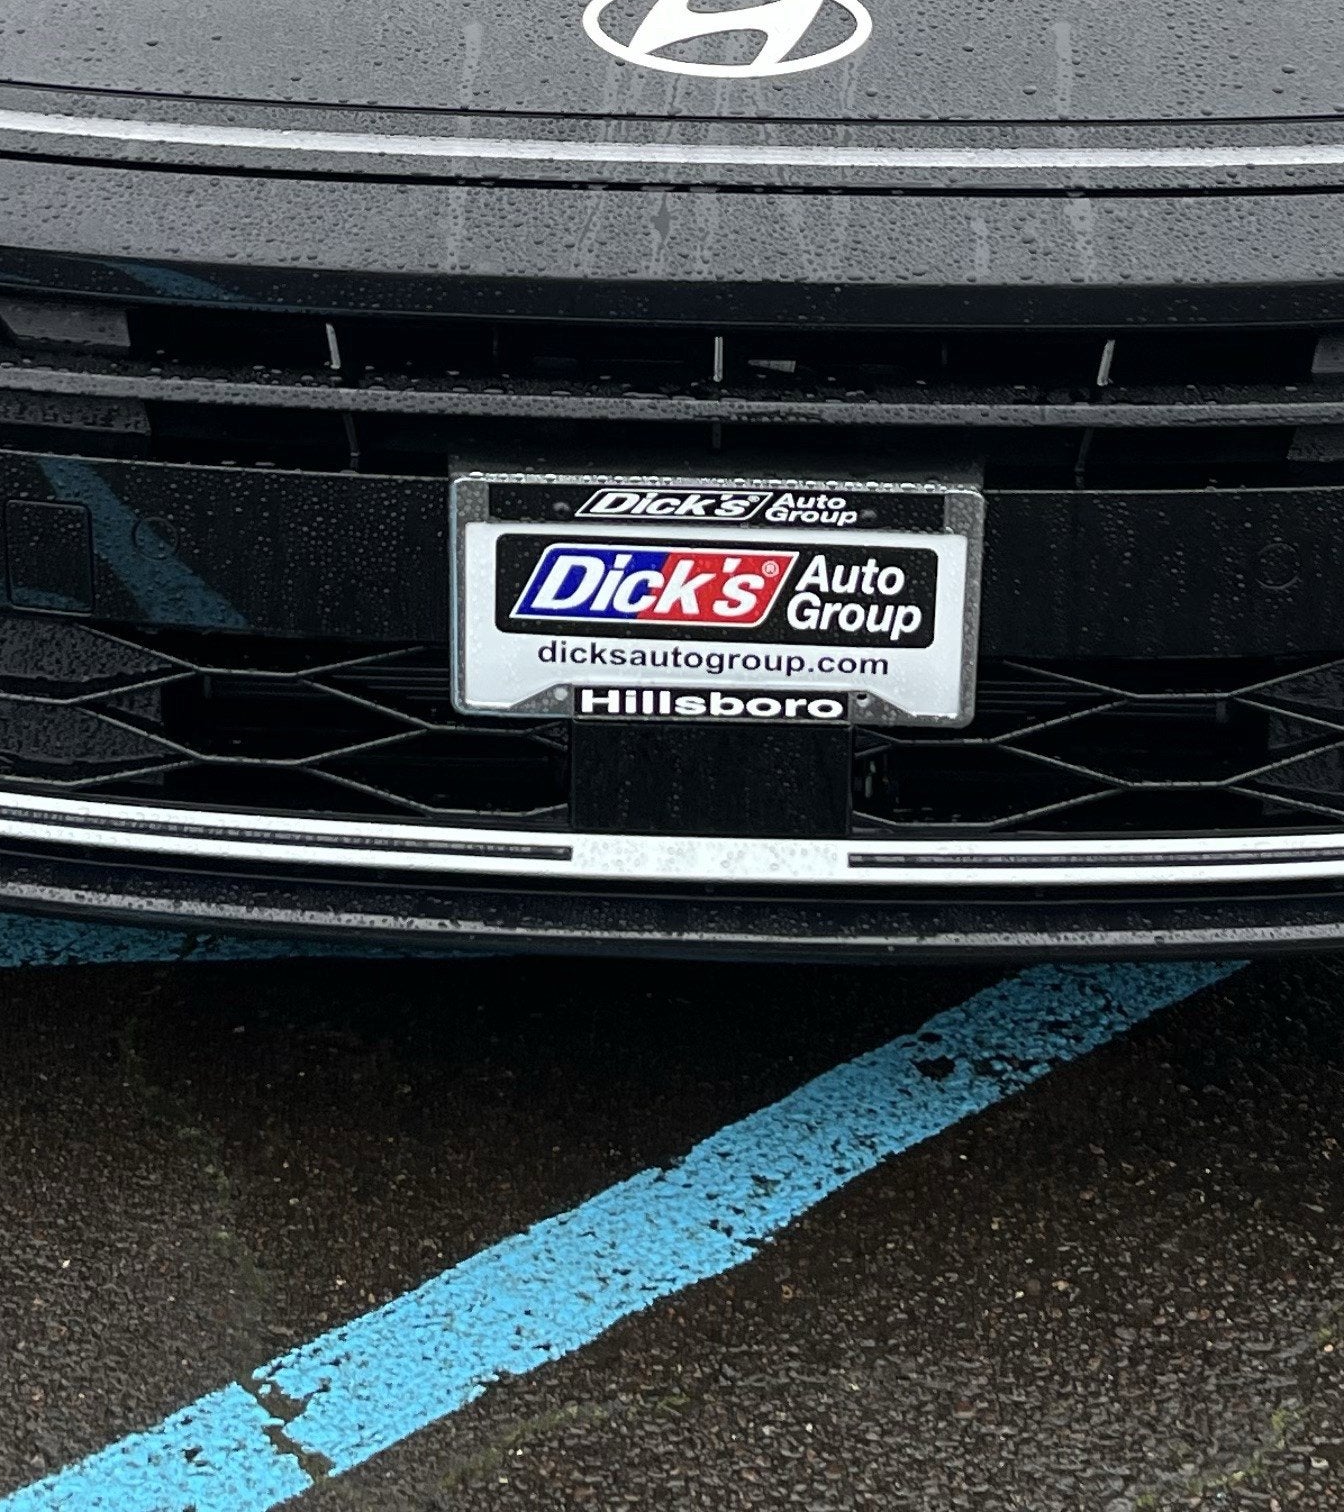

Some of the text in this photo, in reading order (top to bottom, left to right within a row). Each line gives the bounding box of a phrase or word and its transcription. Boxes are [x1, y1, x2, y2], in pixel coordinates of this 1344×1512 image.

[589, 491, 753, 517] Dick's
[764, 506, 858, 527] Group
[771, 493, 847, 510] Auto
[530, 553, 765, 618] Dick's
[794, 554, 905, 596] Auto
[786, 591, 922, 641] Group
[537, 640, 889, 677] dicksautogroup.com
[580, 688, 844, 719] Hillsboro
